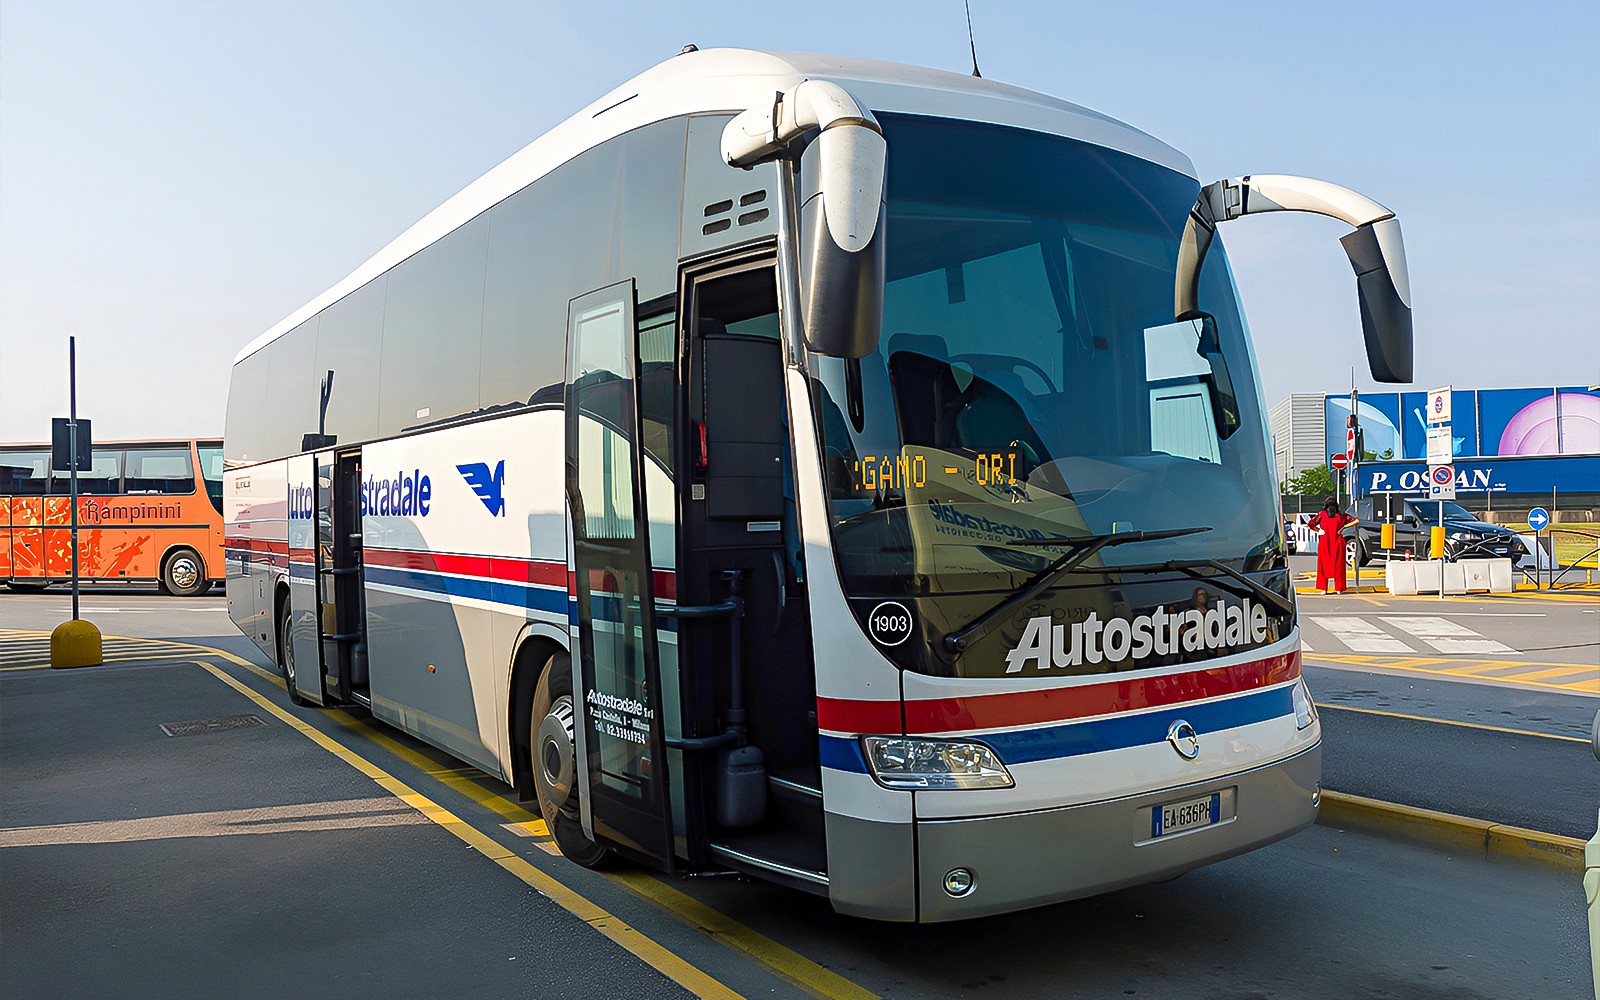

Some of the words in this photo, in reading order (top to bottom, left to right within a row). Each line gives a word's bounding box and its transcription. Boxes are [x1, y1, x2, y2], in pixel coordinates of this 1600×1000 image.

[1371, 472, 1392, 490] P.
[1399, 468, 1492, 489] OSAN
[86, 500, 181, 523] Rampinini
[874, 615, 907, 632] 1903
[1005, 598, 1268, 674] Autostradale
[587, 689, 643, 716] Autostradale
